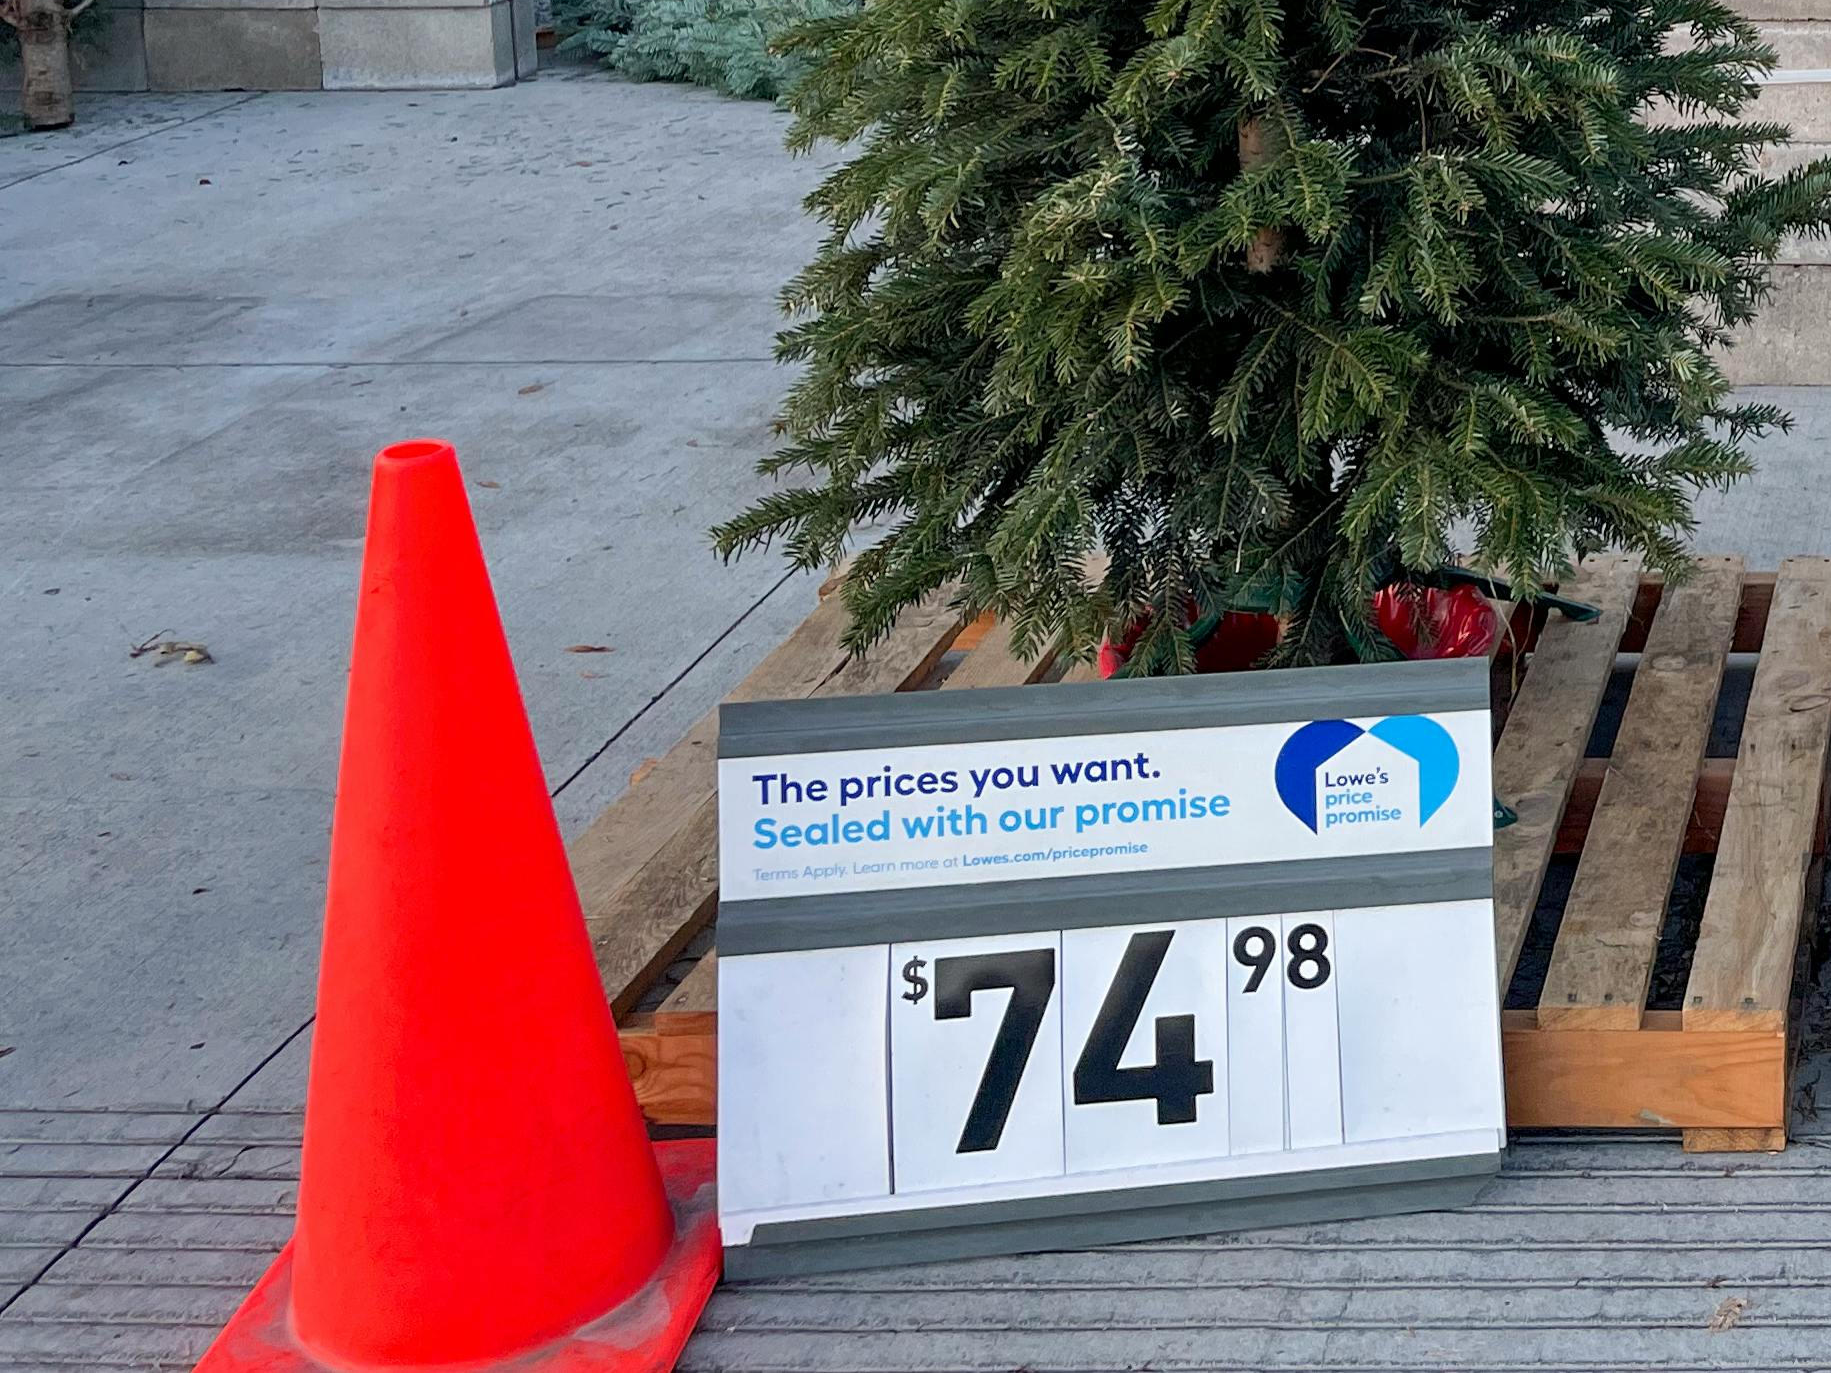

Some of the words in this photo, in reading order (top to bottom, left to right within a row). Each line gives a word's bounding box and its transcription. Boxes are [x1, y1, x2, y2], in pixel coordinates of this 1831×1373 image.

[752, 772, 828, 805] The
[839, 765, 959, 807] prices
[968, 764, 1039, 798] you
[1050, 752, 1161, 785] want.
[1325, 766, 1389, 788] Lowe's
[1325, 788, 1373, 810] price
[752, 810, 891, 849] Sealed
[901, 804, 988, 839] with
[998, 805, 1065, 833] our
[1075, 787, 1231, 833] promise
[1325, 805, 1402, 828] promise
[752, 867, 800, 882] Terms
[801, 863, 848, 881] Apply.
[852, 860, 897, 875] Learn
[900, 858, 940, 872] more
[943, 856, 960, 869] at
[962, 841, 1149, 868] Lowes.com/pricepromise
